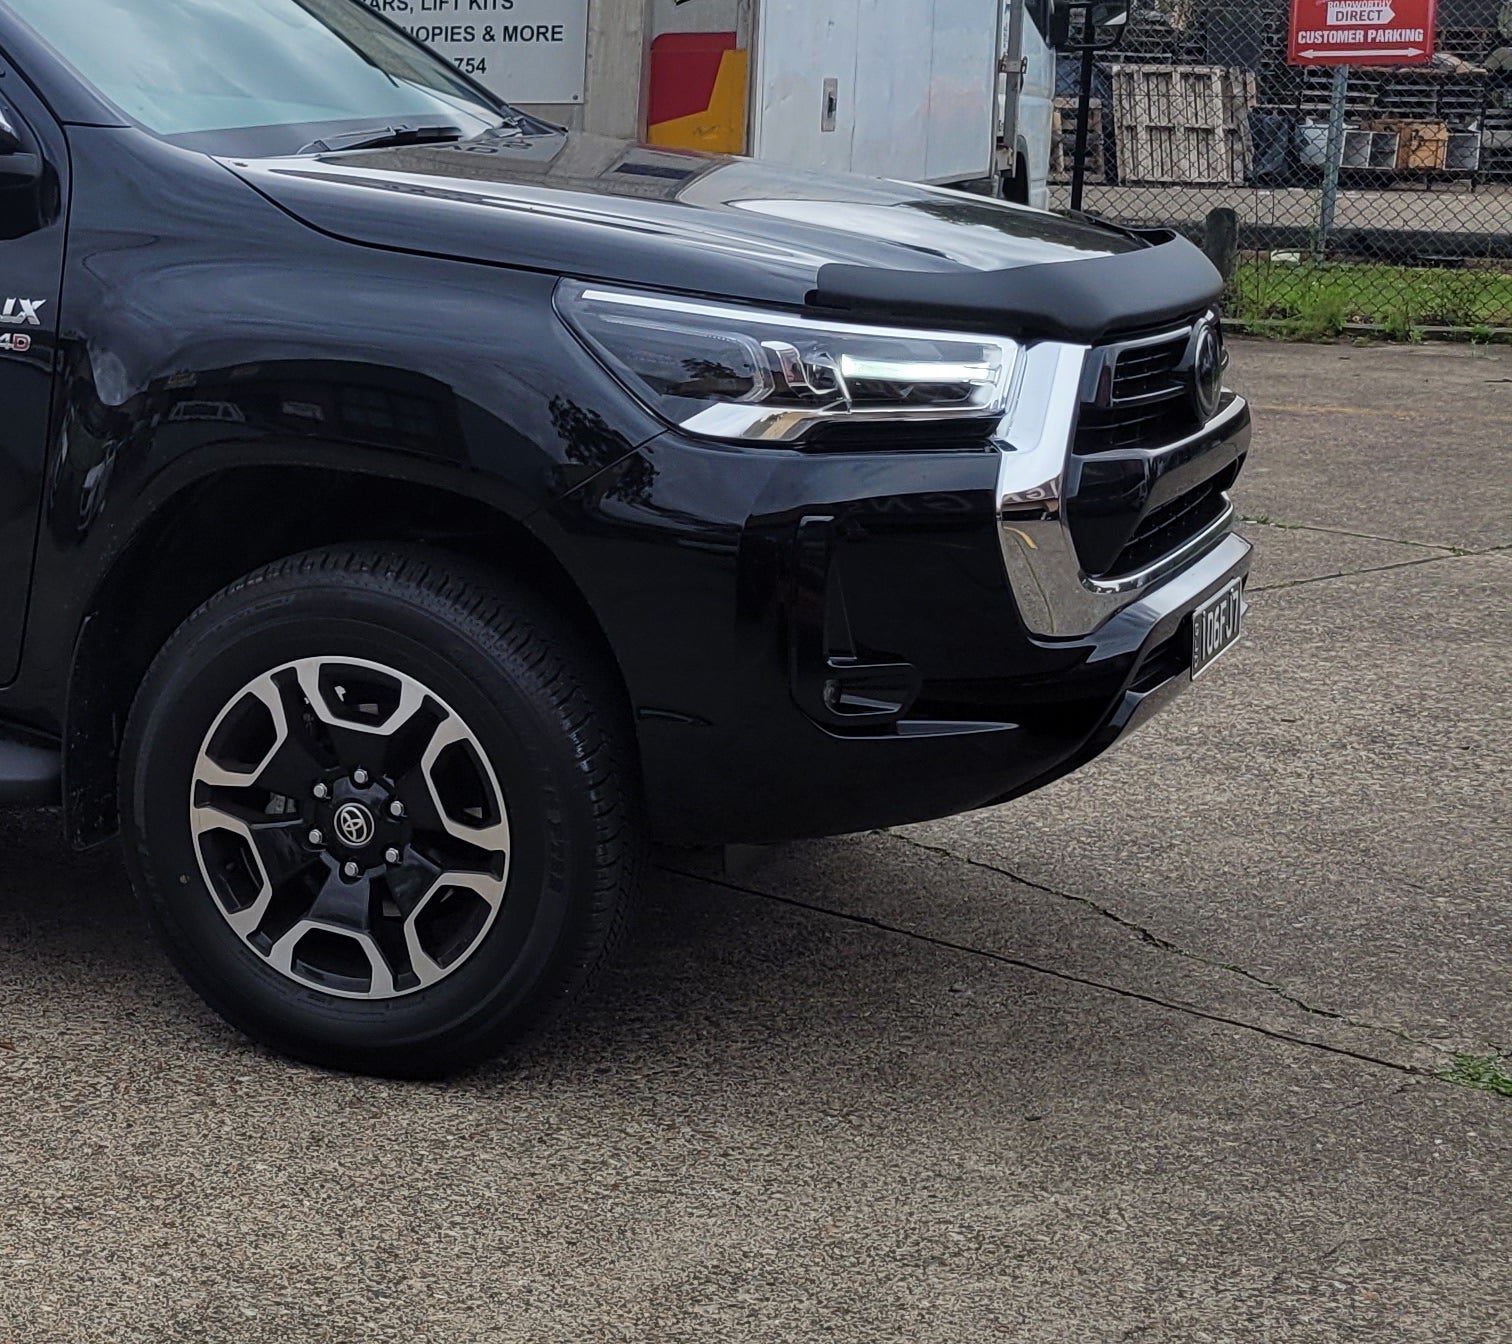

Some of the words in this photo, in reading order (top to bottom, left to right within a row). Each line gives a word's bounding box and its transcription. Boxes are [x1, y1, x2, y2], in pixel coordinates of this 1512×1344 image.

[1328, 0, 1392, 9] ROADWORTHY
[1335, 10, 1383, 22] DIRECT
[483, 25, 496, 43] &
[503, 25, 564, 42] MORE
[1298, 30, 1364, 44] CUSTOMER
[1367, 28, 1424, 43] PARKING
[1202, 590, 1239, 661] 106FJ7
